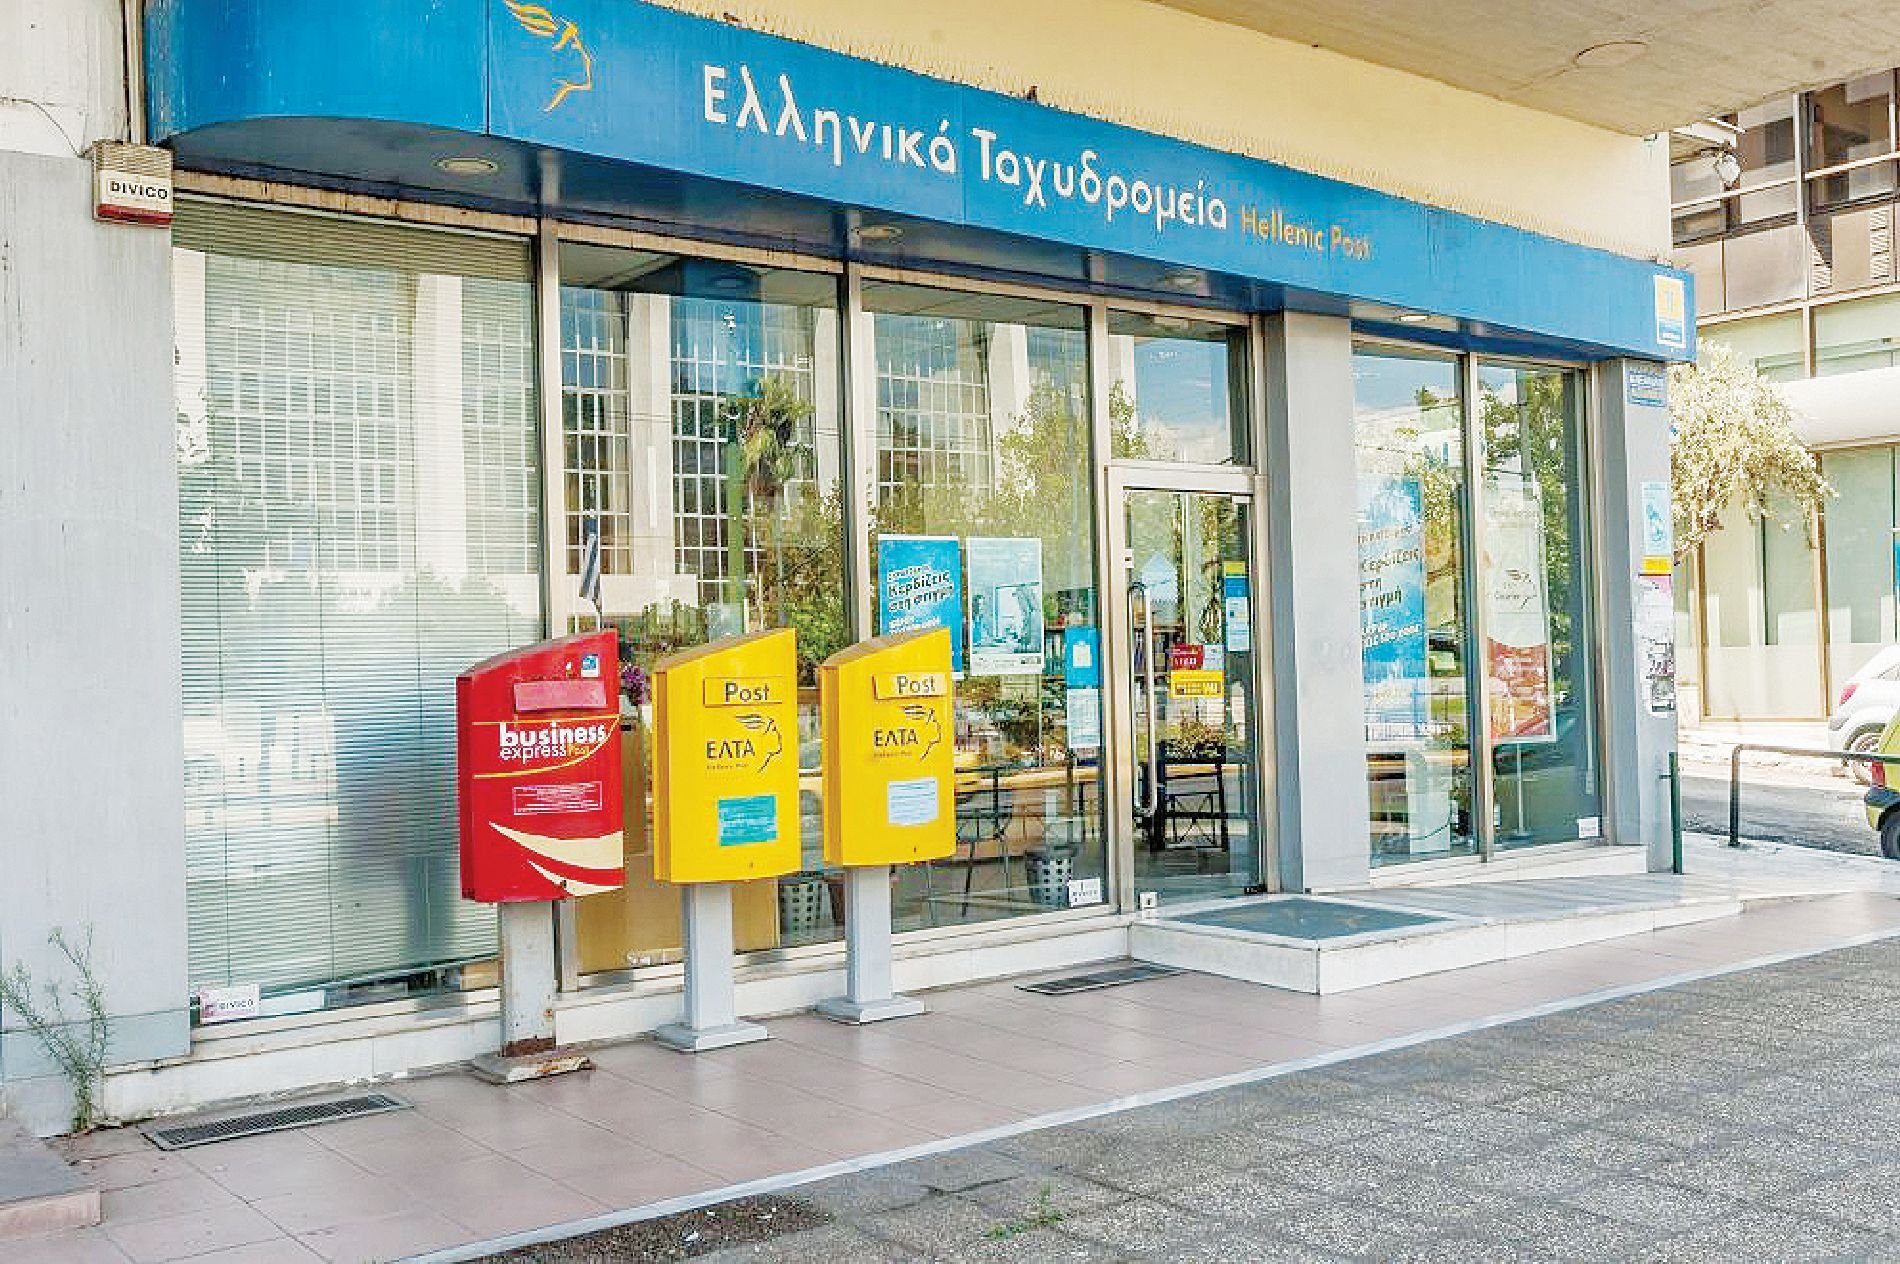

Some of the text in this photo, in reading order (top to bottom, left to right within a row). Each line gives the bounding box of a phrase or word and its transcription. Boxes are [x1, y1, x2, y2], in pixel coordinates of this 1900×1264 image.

[704, 64, 1227, 232] Ελληνικά Ταχυδρομεία
[110, 180, 168, 199] DIVICO
[1241, 205, 1374, 260] Hellenic Post
[724, 682, 770, 703] Post
[895, 675, 936, 695] Post
[499, 720, 606, 747] business
[873, 727, 919, 748] ΕΛΤΑ
[706, 738, 755, 760] ΕΛΤΑ
